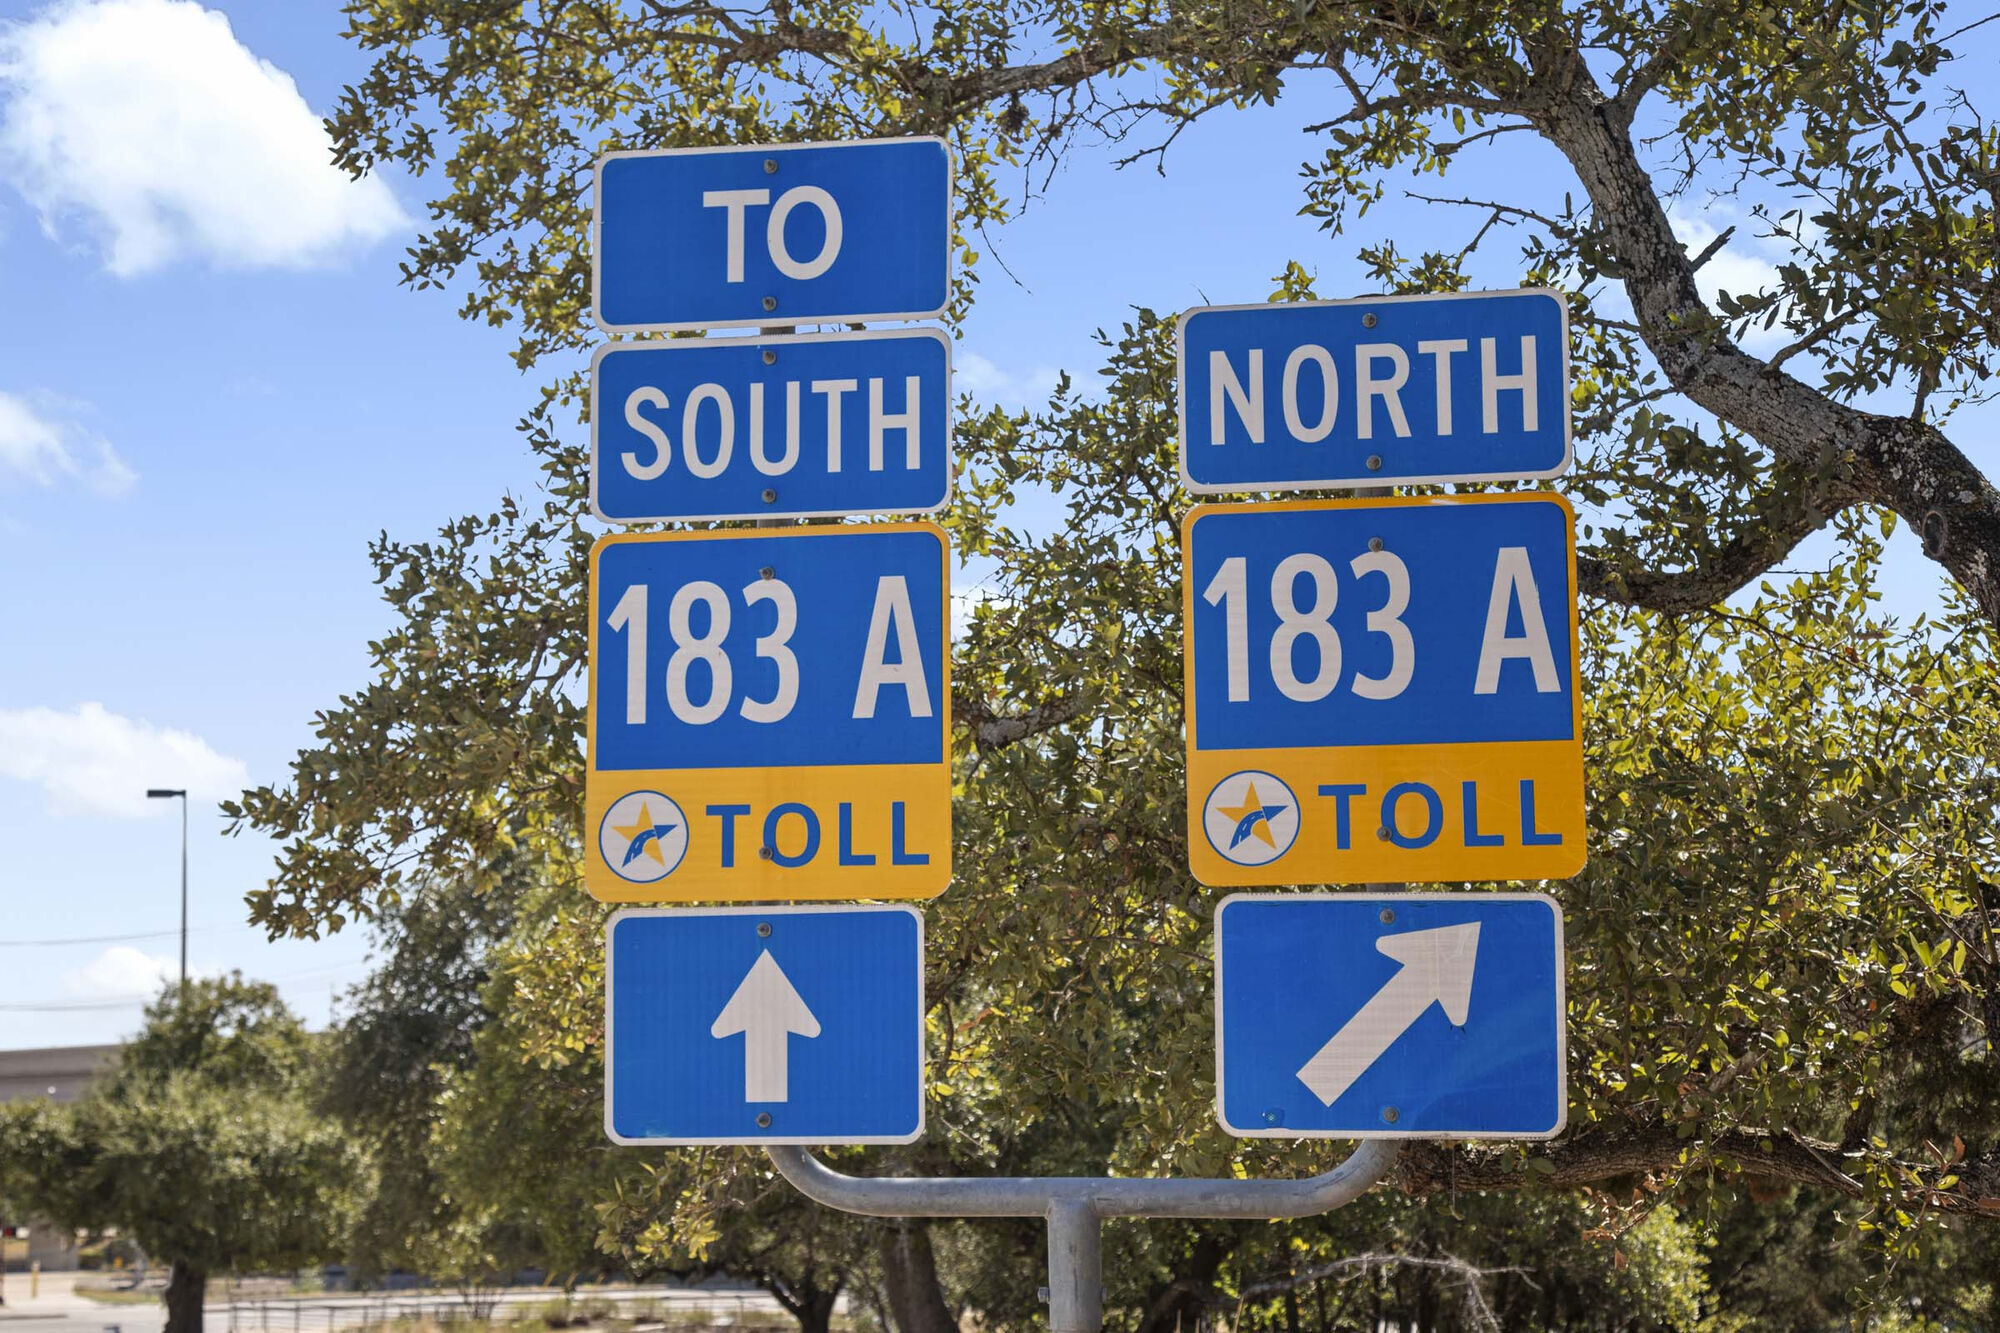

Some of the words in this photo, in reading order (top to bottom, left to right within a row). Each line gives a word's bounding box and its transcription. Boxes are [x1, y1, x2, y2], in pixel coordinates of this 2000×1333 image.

[702, 185, 843, 283] TO
[620, 375, 922, 481] SOUTH
[1208, 334, 1540, 446] NORTH
[607, 577, 800, 726] 183
[852, 574, 932, 720] A
[1203, 549, 1416, 703] 183
[1473, 545, 1562, 695] A
[705, 800, 930, 868] TOLL
[1318, 778, 1563, 850] TOLL
